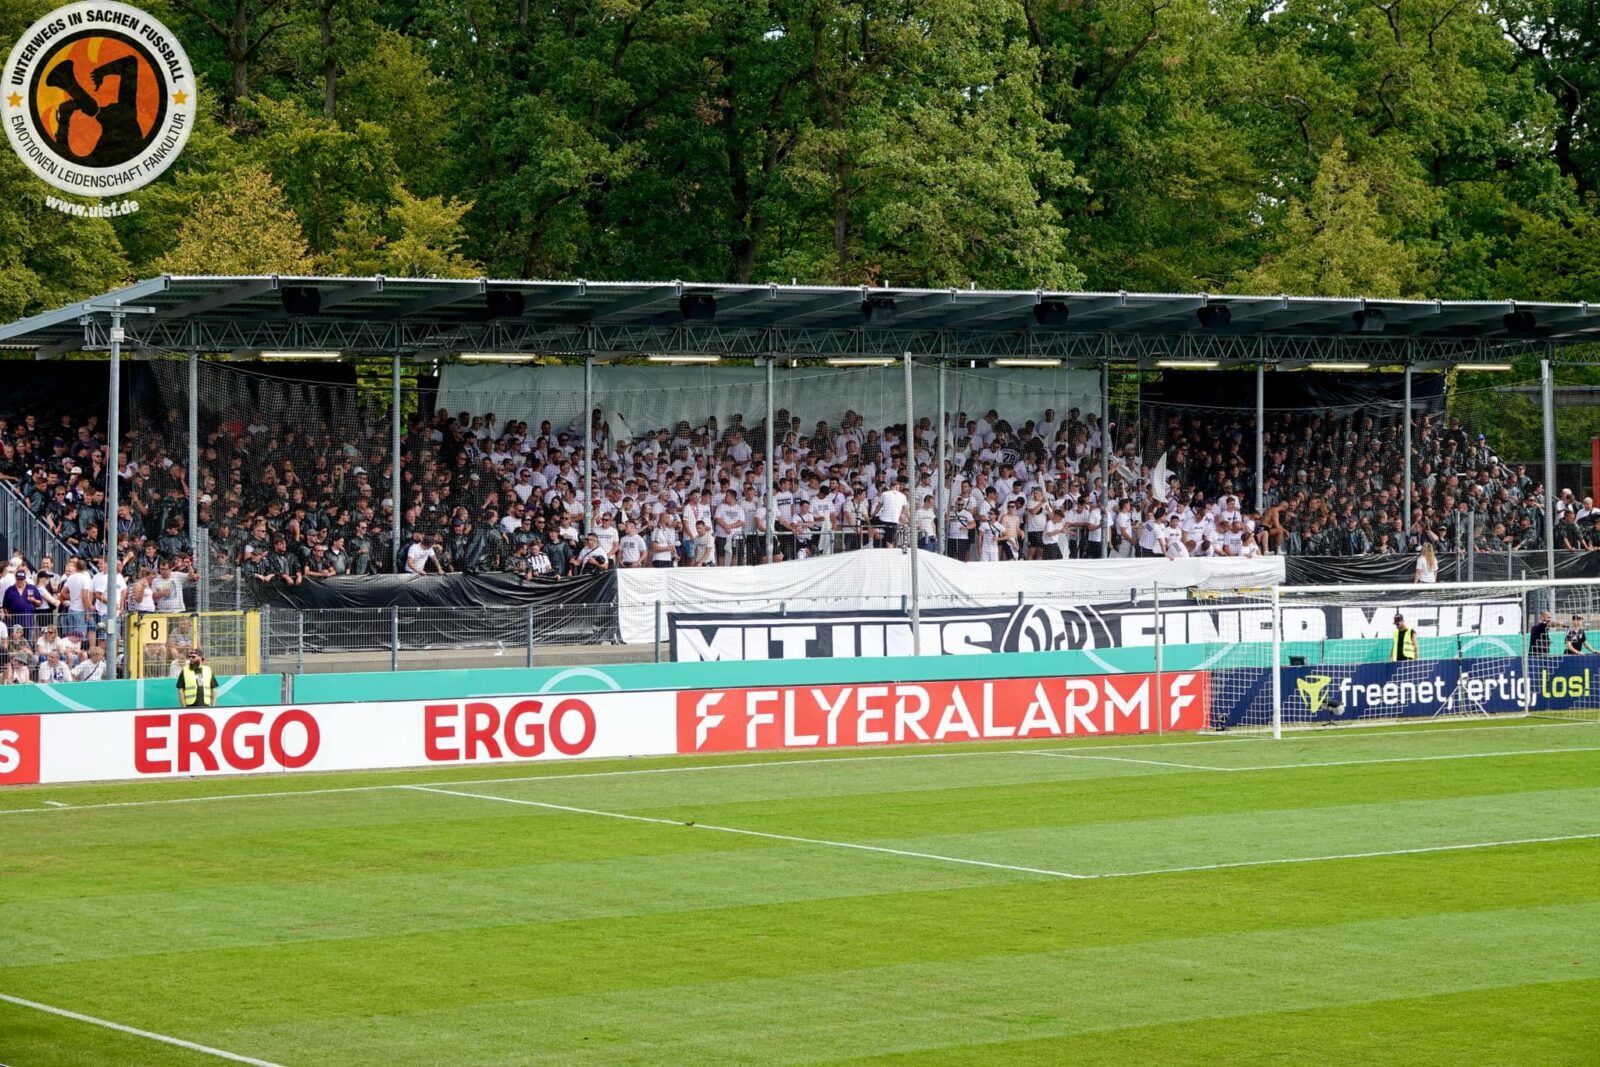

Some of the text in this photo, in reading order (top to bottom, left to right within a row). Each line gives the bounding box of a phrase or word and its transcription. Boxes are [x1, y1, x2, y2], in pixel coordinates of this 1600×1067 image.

[151, 620, 160, 641] 8
[747, 677, 1150, 747] FLYERALARM
[1542, 668, 1591, 698] los!
[134, 709, 321, 774] ERGO
[424, 698, 597, 761] ERGO
